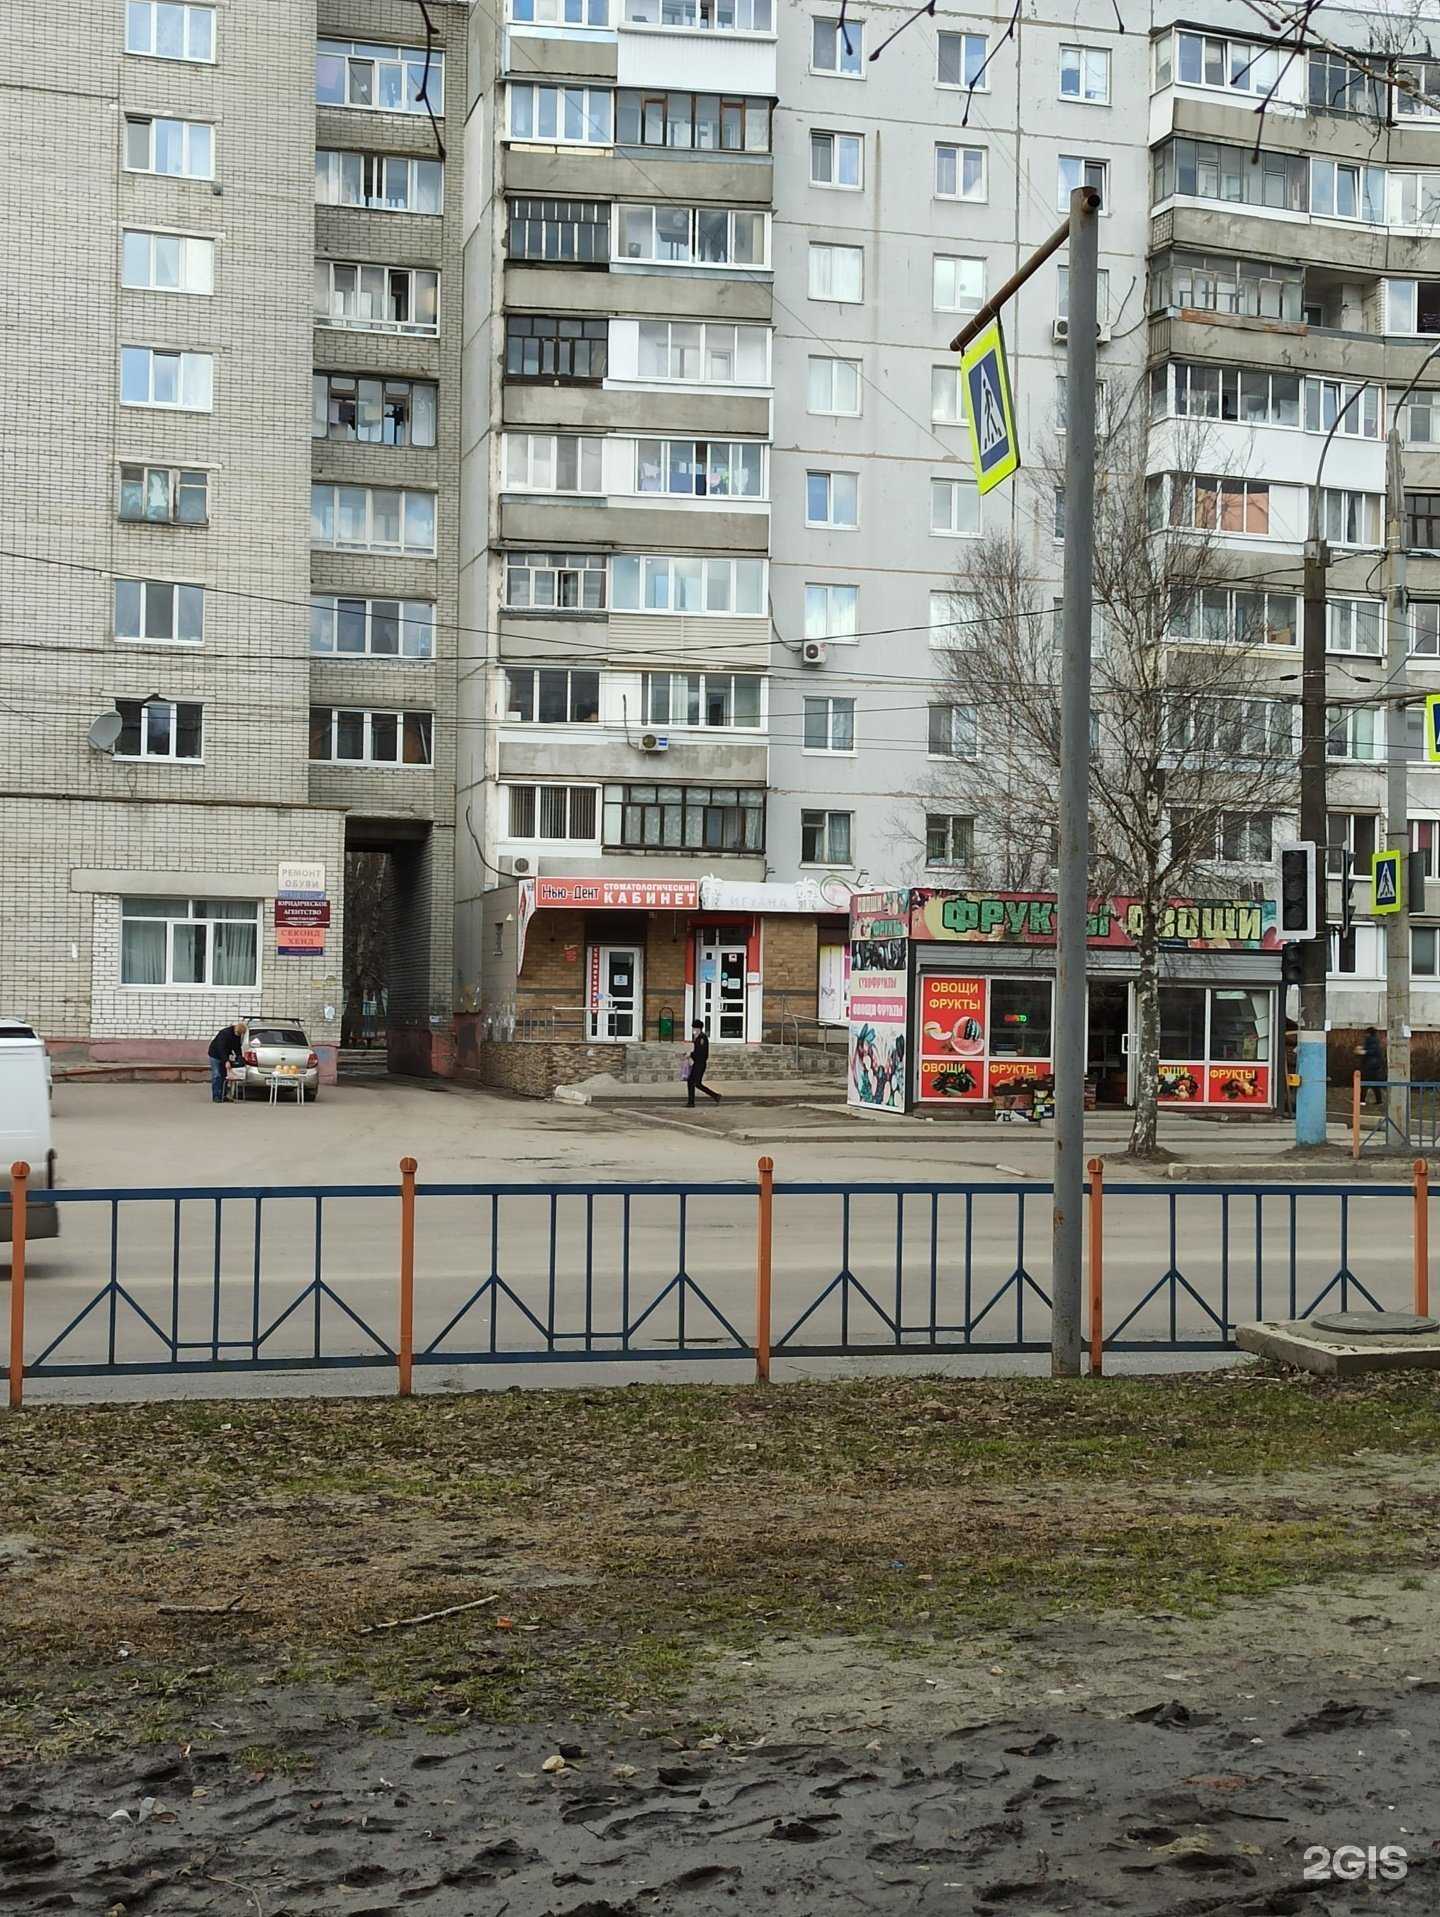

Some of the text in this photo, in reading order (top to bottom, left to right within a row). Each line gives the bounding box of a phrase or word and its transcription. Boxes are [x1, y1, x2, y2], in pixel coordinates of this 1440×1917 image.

[282, 869, 322, 878] РЕМОНТ
[285, 880, 319, 889] ОБУВИ
[603, 882, 695, 893] СТОМАТОЛОГИЧЕСКИЙ
[542, 884, 599, 900] Нью-Дент
[603, 892, 695, 905] КАБИНЕТ
[943, 899, 1110, 938] ФРУКЫ
[281, 929, 320, 938] СЕКОНД
[288, 938, 314, 946] ХЕНД
[931, 982, 979, 996] ОВОЩИ
[929, 998, 981, 1011] ФРУКТЫ
[922, 1062, 966, 1074] ОВОЩИ
[989, 1064, 1037, 1075] ФРУКТЫ
[1209, 1069, 1256, 1080] ФРУКТЫ
